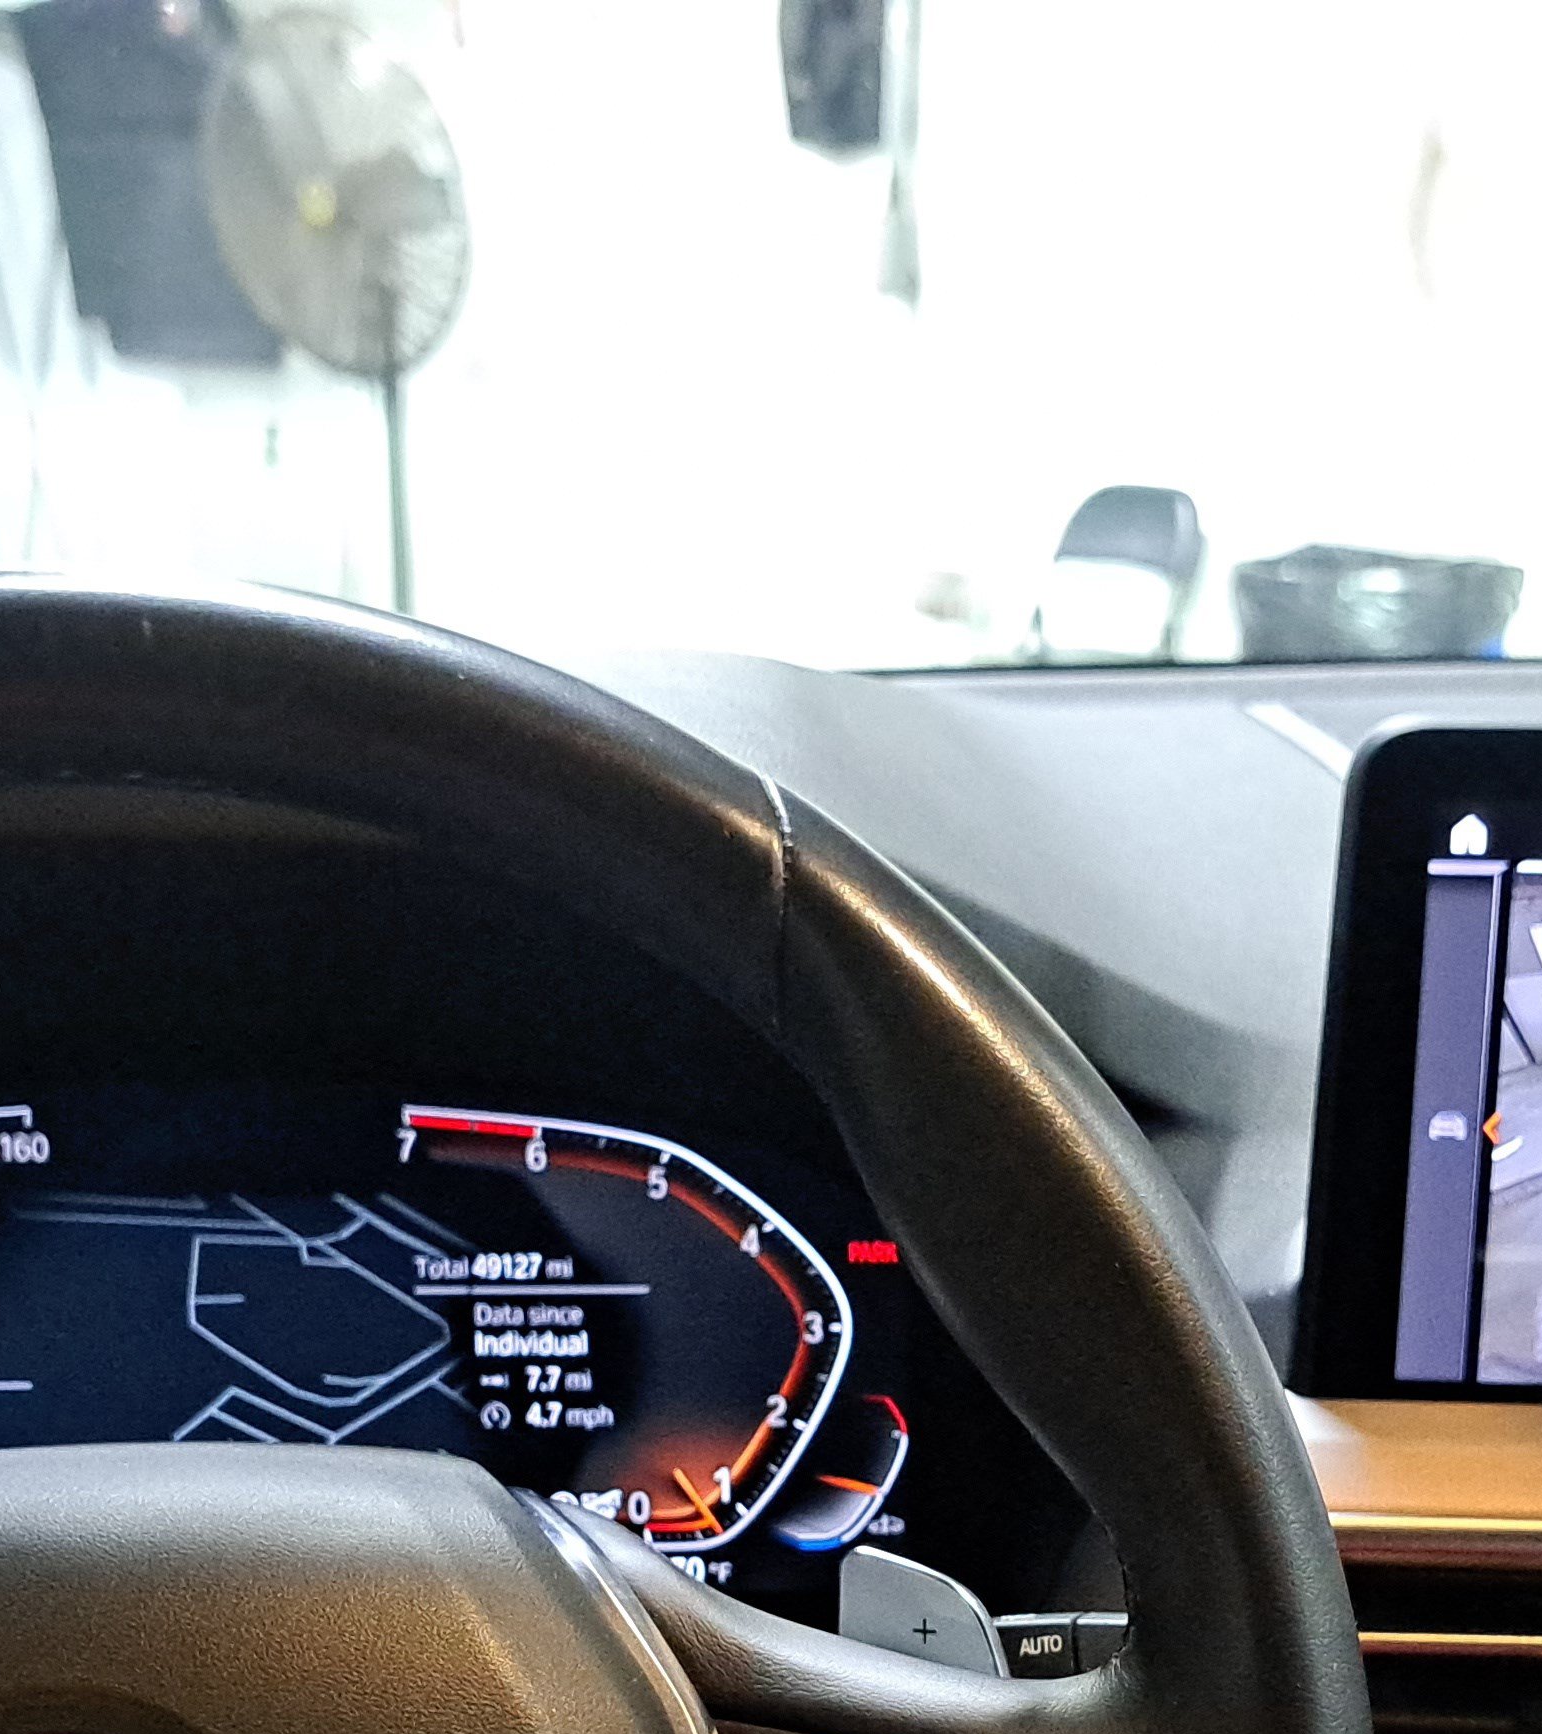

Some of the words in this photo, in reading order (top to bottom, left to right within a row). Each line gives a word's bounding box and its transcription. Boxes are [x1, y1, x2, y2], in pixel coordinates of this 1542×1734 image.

[0, 1133, 50, 1164] 160
[396, 1127, 417, 1164] 7
[524, 1140, 548, 1171] 6
[647, 1168, 668, 1199] 5
[740, 1224, 760, 1256] 4
[412, 1254, 469, 1280] Total
[471, 1252, 542, 1280] 49127
[544, 1255, 574, 1279] mi
[473, 1301, 525, 1327] Data
[527, 1304, 584, 1327] since
[803, 1311, 824, 1343] 3
[473, 1330, 589, 1357] Individual
[524, 1365, 562, 1392] 7.7
[564, 1368, 593, 1392] mi
[525, 1401, 562, 1427] 4.7
[565, 1404, 615, 1431] mph
[766, 1394, 787, 1428] 2
[713, 1466, 732, 1504] 1
[627, 1491, 652, 1525] 0
[1020, 1634, 1063, 1657] AUTO
